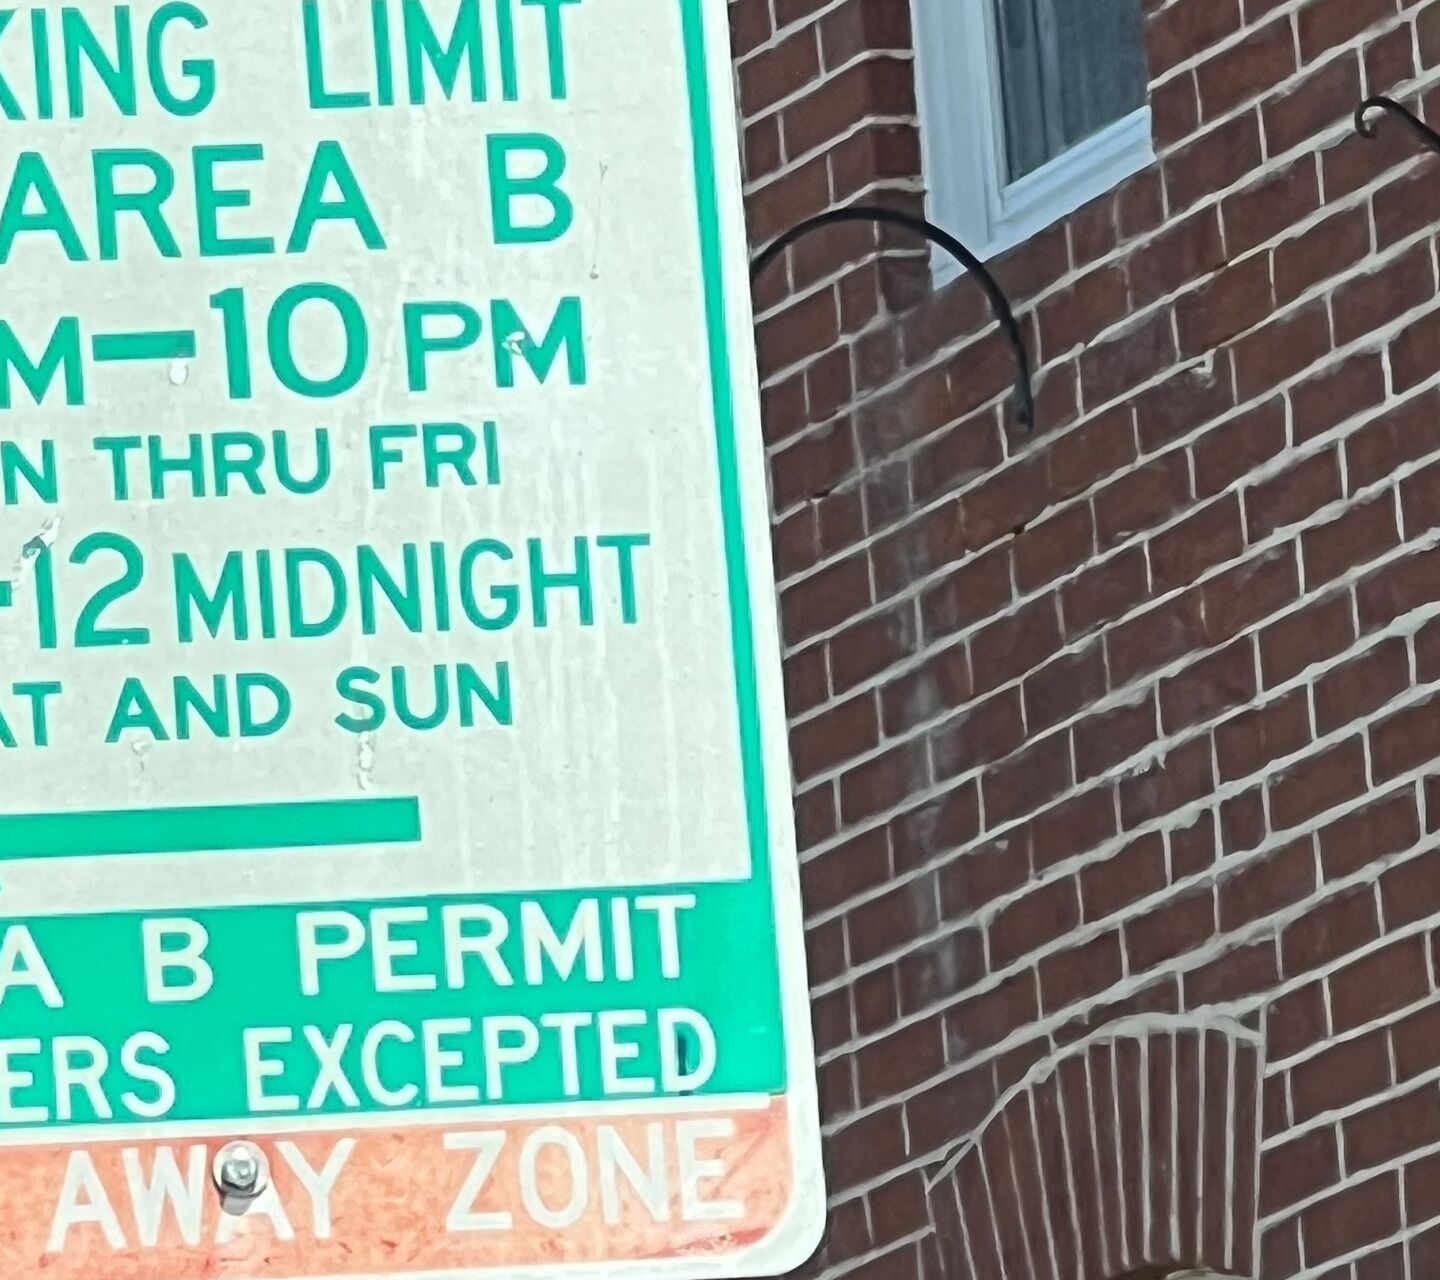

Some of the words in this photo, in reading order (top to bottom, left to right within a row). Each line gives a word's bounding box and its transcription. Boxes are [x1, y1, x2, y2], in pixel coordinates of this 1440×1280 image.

[487, 133, 574, 246] B
[92, 427, 331, 500] THRU
[368, 421, 500, 490] FRI
[171, 533, 650, 643] MIDNIGHT
[103, 672, 291, 744] AND
[334, 661, 513, 732] SUN
[142, 917, 214, 1002] B
[299, 894, 695, 996] PERMIT
[243, 1007, 717, 1112] EXCEPTED
[47, 1137, 356, 1253] AWAY
[444, 1120, 746, 1233] ZONE
